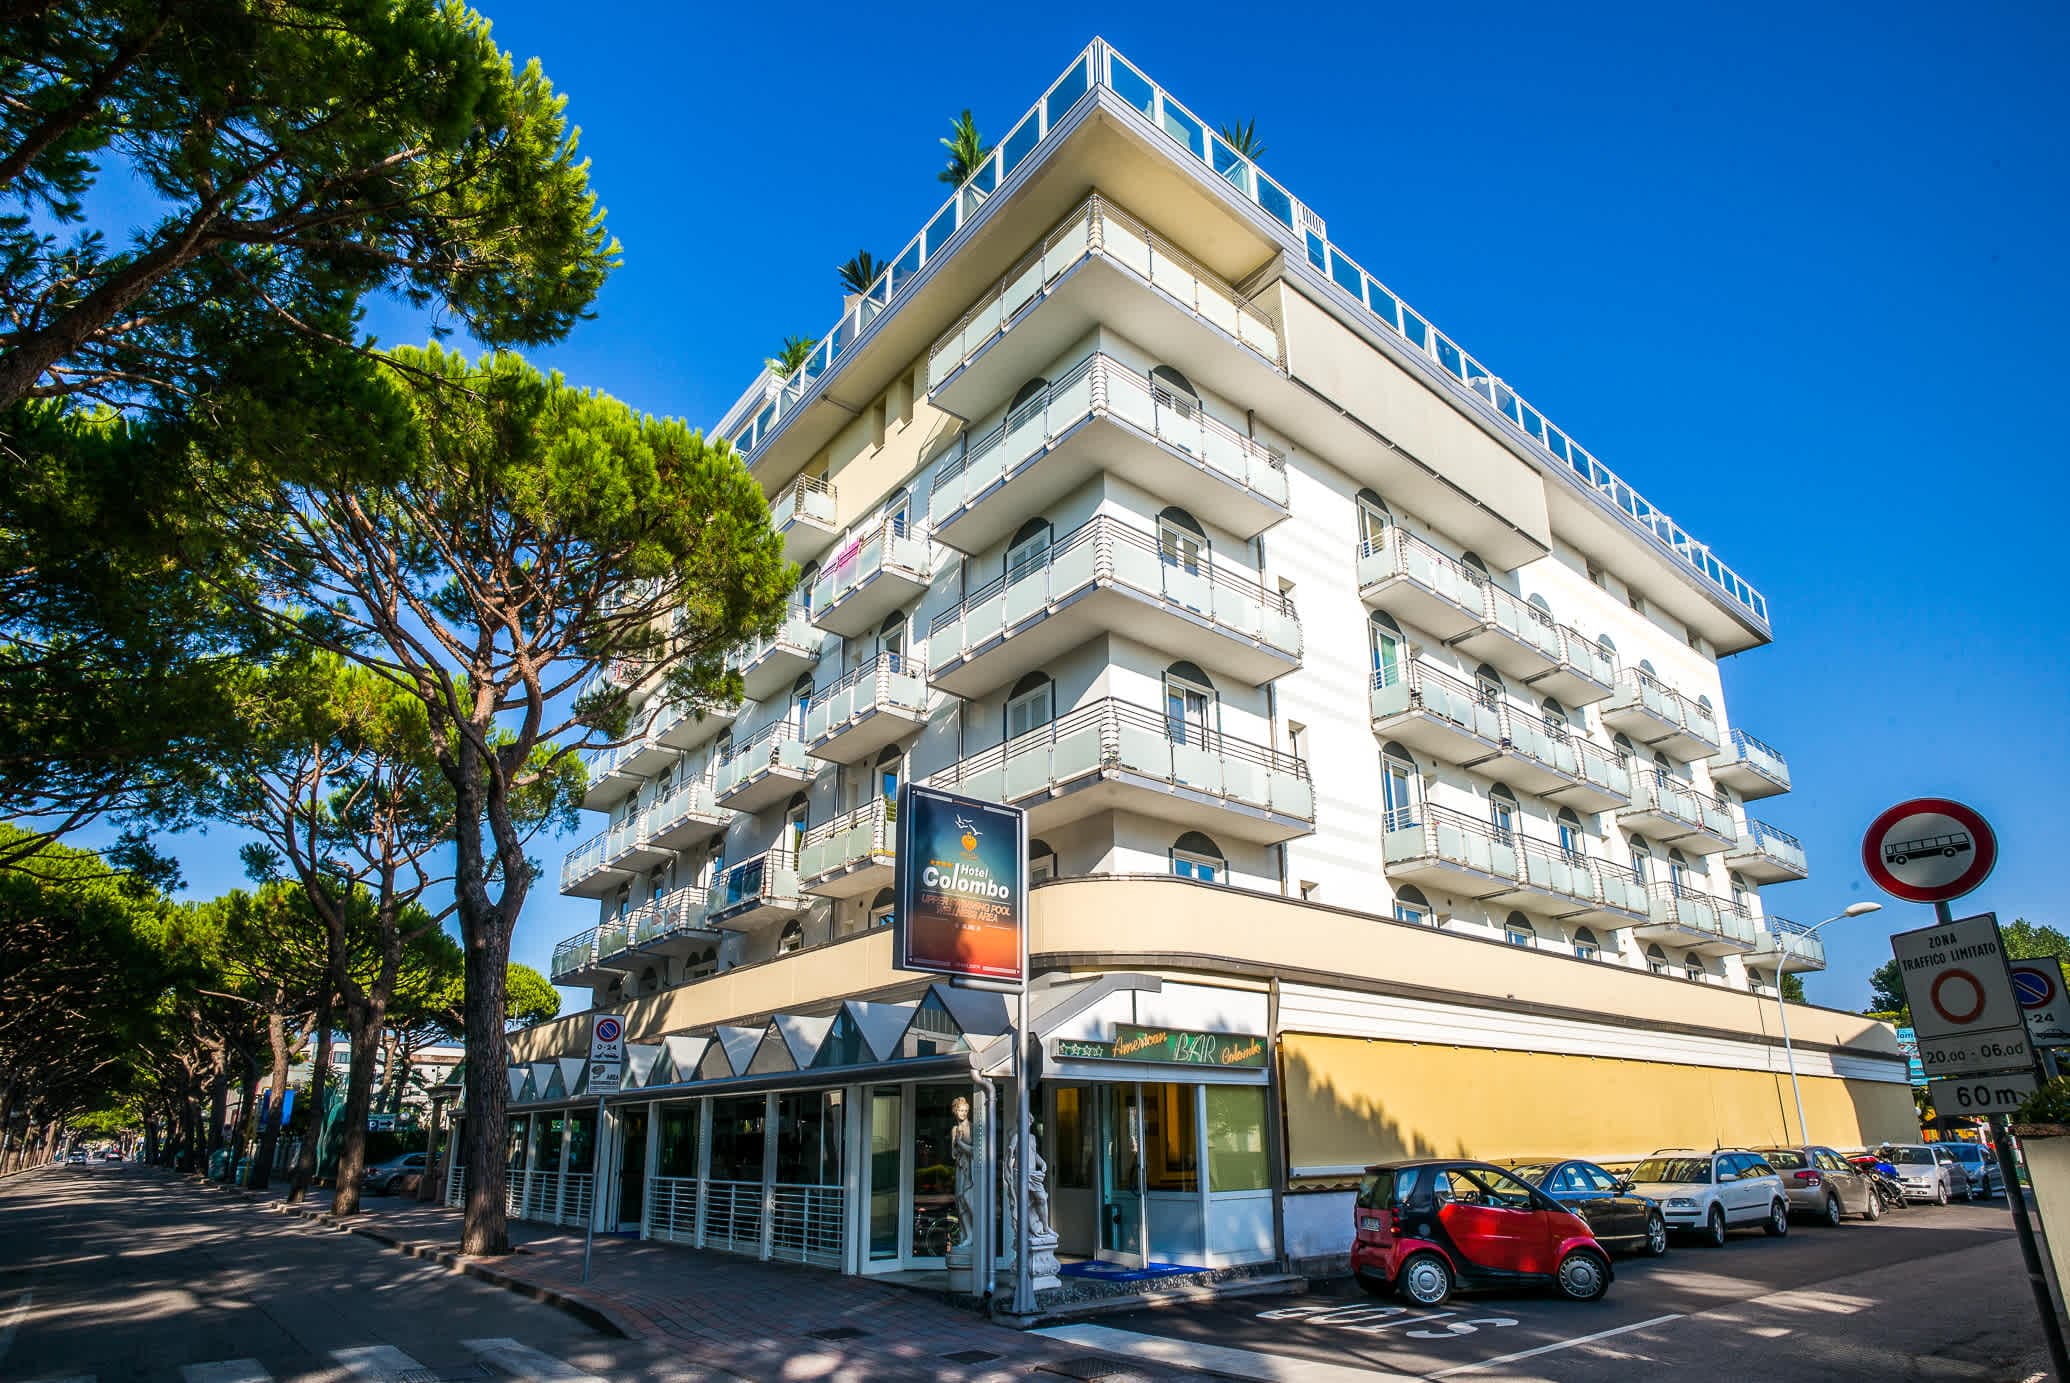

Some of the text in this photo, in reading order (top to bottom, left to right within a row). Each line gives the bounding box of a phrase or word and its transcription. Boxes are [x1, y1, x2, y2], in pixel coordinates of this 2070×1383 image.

[961, 864, 988, 878] Hotel
[923, 863, 1009, 899] Colombo
[991, 904, 1011, 915] POOL
[1929, 933, 1957, 948] ZONA
[1903, 943, 1996, 971] TRAFFICO LIMITATO
[2028, 1012, 2055, 1023] -24
[1112, 1032, 1262, 1064] American BAR Colombo
[1927, 1050, 1966, 1064] 20.00
[1981, 1042, 2024, 1058] 06.00
